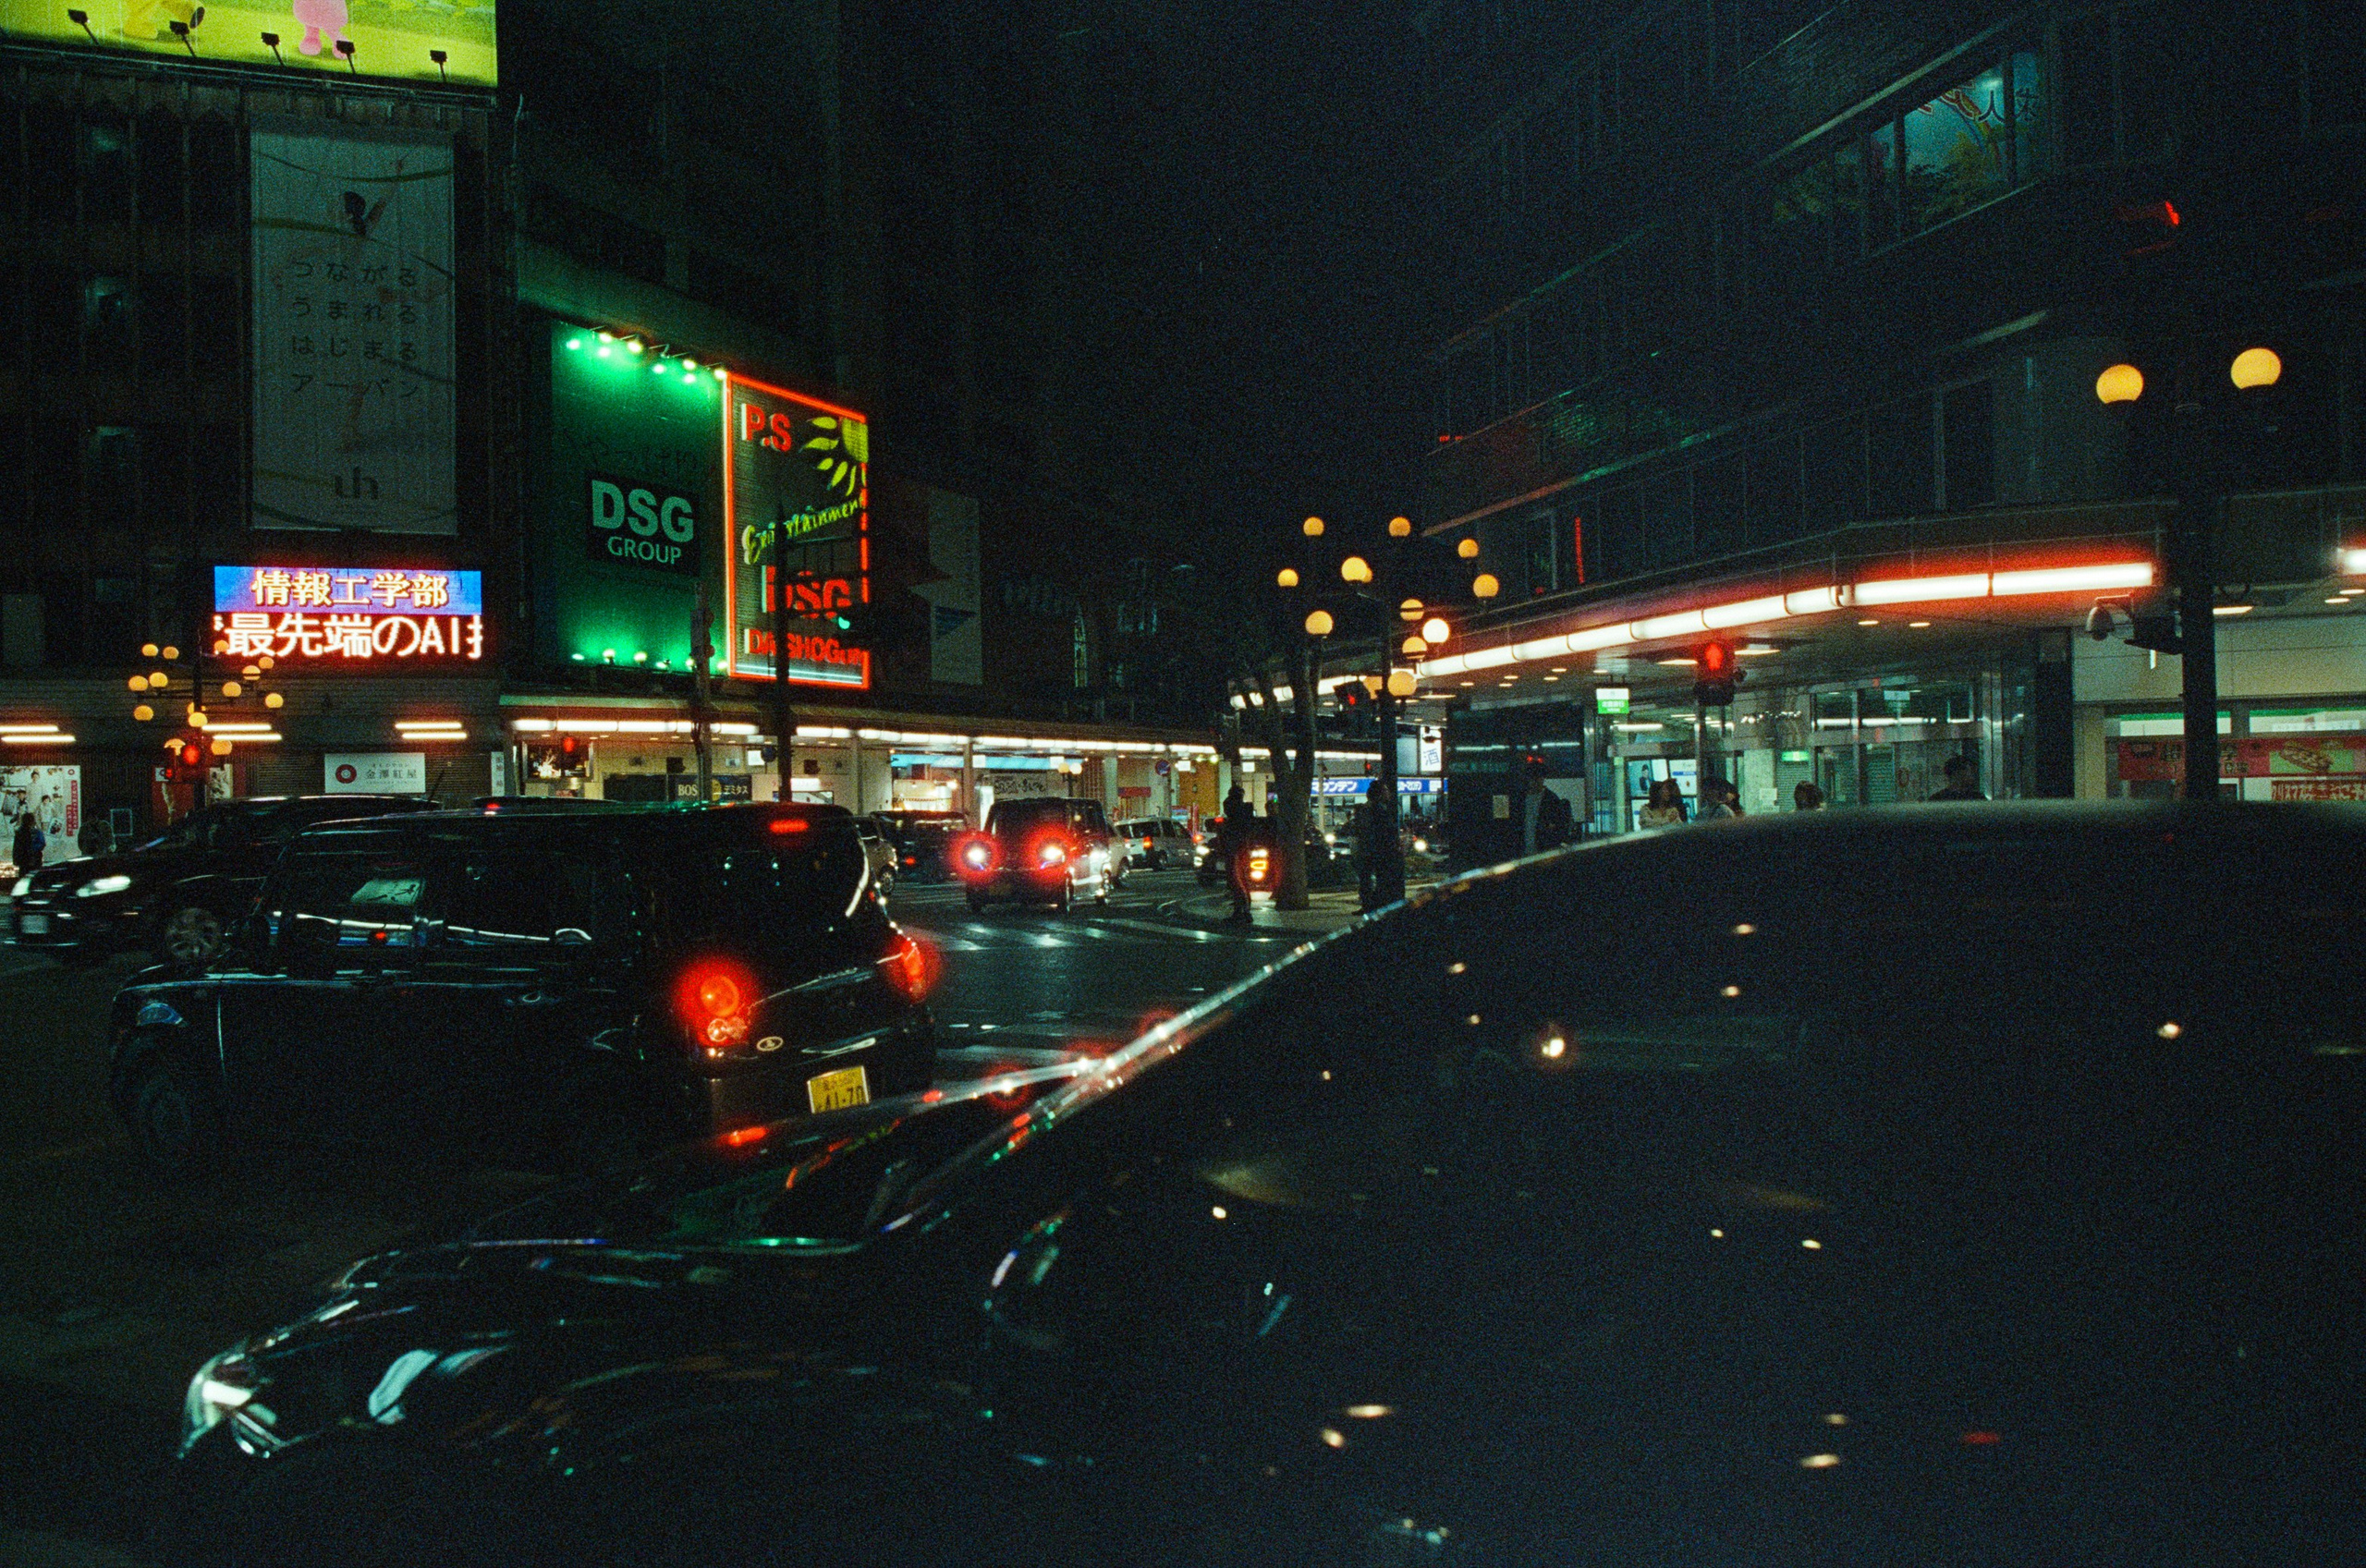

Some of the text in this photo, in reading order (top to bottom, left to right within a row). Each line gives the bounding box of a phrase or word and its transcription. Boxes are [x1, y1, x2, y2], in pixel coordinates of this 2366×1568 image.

[290, 260, 417, 287] つながる
[291, 295, 418, 324] うまれる
[291, 335, 418, 362] はじまる
[291, 373, 420, 398] アーバン
[591, 479, 695, 542] DSG
[606, 535, 682, 565] GROUP
[250, 568, 449, 609] 情報工学部
[724, 784, 749, 796] デミタス
